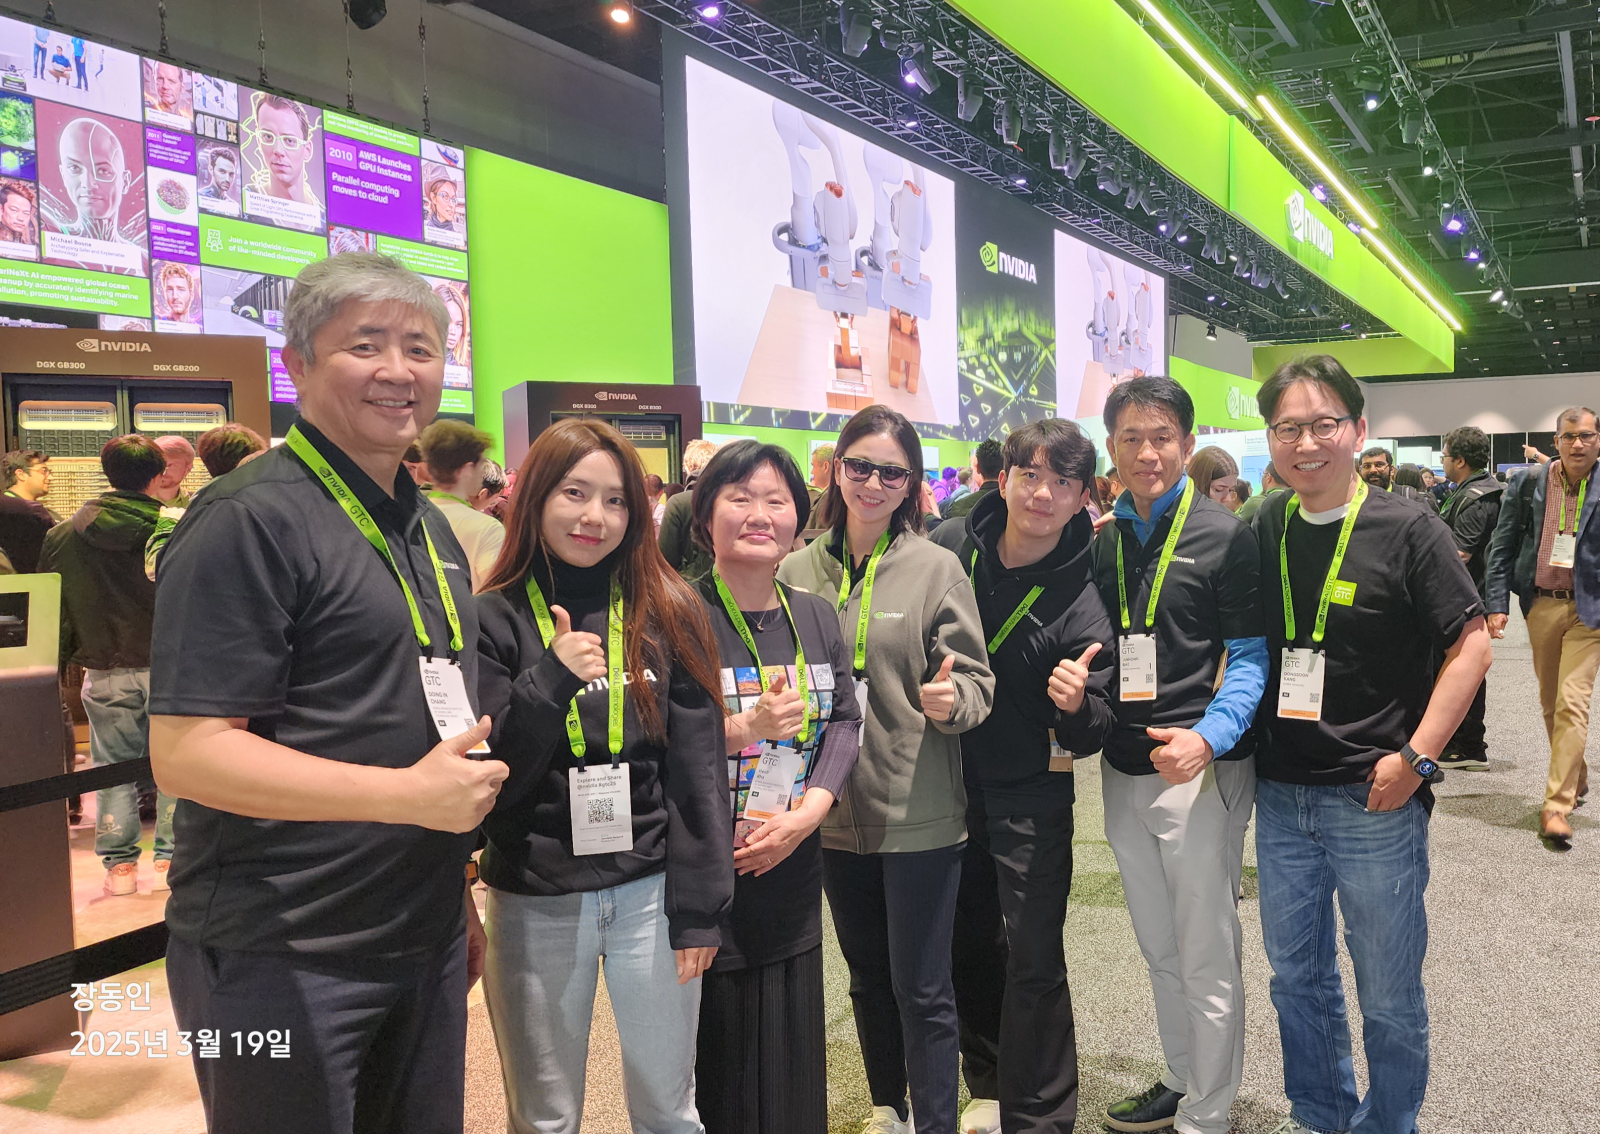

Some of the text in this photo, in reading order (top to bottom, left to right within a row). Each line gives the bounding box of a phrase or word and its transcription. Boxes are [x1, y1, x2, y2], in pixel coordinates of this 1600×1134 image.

[329, 147, 352, 161] 2010
[359, 150, 412, 172] AWS Launches
[359, 162, 412, 182] GPU Instances
[332, 172, 400, 198] Parallel computing
[332, 184, 388, 205] moves to cloud
[1304, 206, 1334, 260] NVIDIA
[228, 236, 242, 244] Join
[249, 240, 281, 251] worldwide
[282, 246, 317, 258] community
[237, 246, 275, 259] like-minded
[999, 251, 1037, 285] NVIDIA
[0, 268, 29, 277] ariNeXt
[41, 273, 84, 285] empowered
[86, 279, 107, 288] global
[108, 282, 130, 290] ocean
[0, 277, 139, 300] eanup by accurately identifying marine
[0, 286, 119, 307] llution, promoting sustainability.
[101, 341, 152, 352] NVIDIA
[57, 361, 86, 369] GB300
[1240, 394, 1260, 418] NVID
[328, 477, 370, 527] NVIDIA GTC
[1167, 514, 1184, 549] NVIDIA GTC
[1337, 540, 1346, 557] DELL
[1157, 564, 1165, 583] DELL
[1325, 575, 1334, 591] GTC
[1334, 591, 1351, 600] GTC
[726, 596, 751, 643] DELL Technologies
[1017, 603, 1028, 616] DELL
[1027, 612, 1044, 627] NVIDIA
[611, 627, 620, 645] GTC
[425, 676, 441, 686] GTC
[587, 668, 657, 691] NVDA
[611, 667, 621, 728] DELL Technologies
[762, 757, 778, 766] GTC
